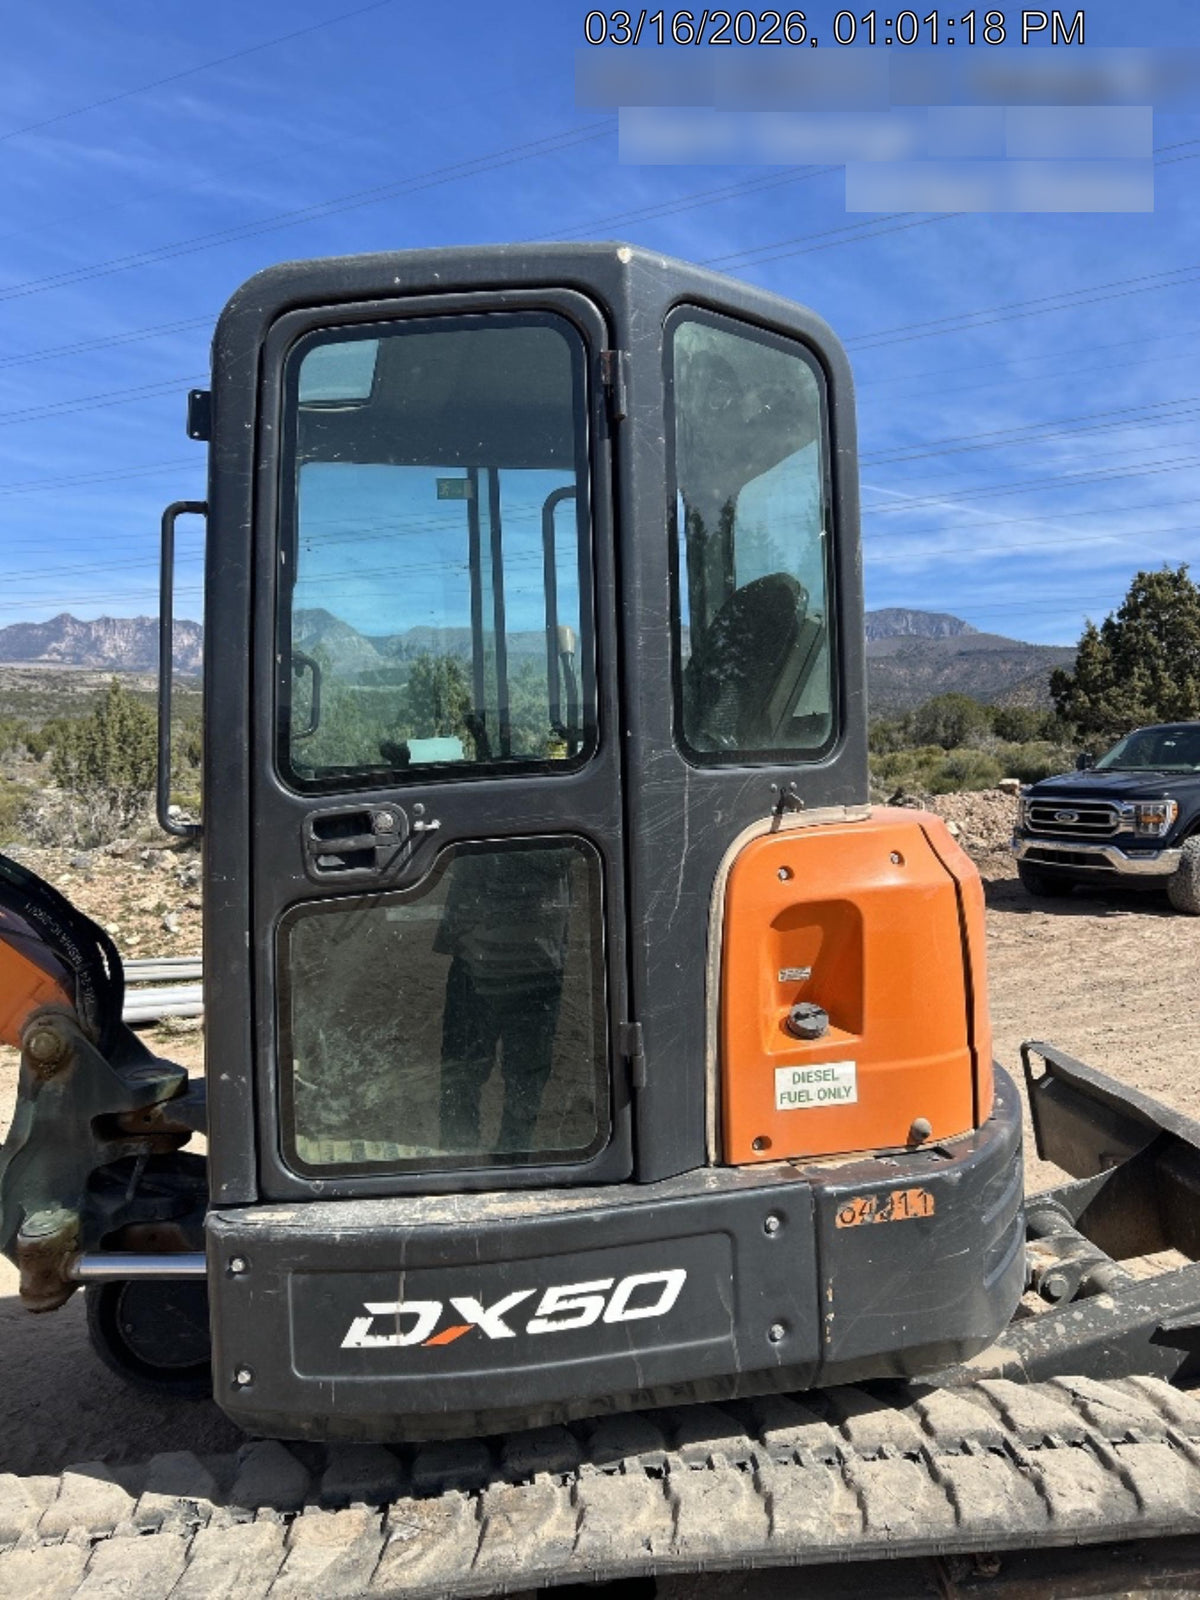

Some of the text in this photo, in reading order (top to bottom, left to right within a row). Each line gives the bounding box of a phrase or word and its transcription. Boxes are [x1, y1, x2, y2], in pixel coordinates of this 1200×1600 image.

[792, 1068, 840, 1085] DIESEL
[780, 1086, 853, 1105] FUEL ONLY
[341, 1269, 687, 1348] DX50
